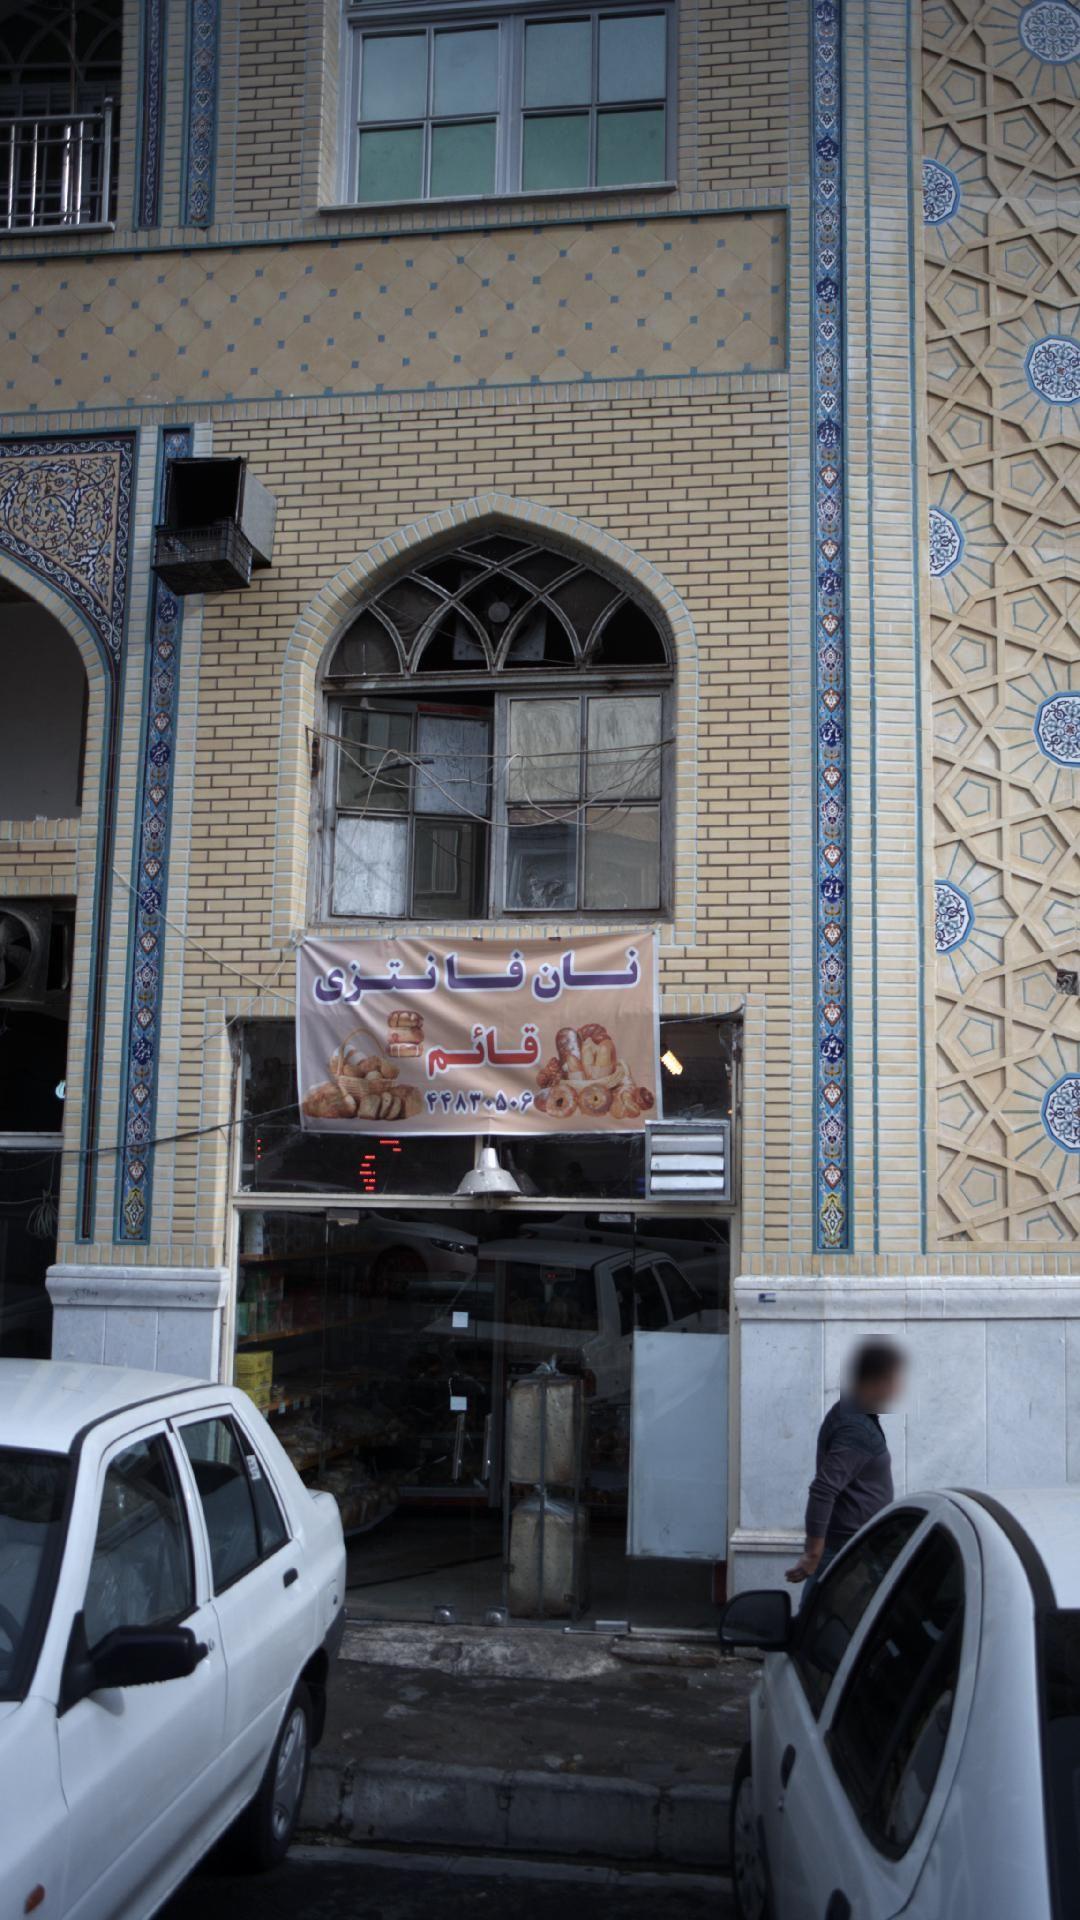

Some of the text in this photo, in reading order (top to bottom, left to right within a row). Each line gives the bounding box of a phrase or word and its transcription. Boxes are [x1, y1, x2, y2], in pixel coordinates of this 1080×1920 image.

[314, 947, 639, 1003] نان فانتزی
[427, 1024, 541, 1078] قائم
[426, 1089, 533, 1113] ۴۴۸۳۰۵۰۶
